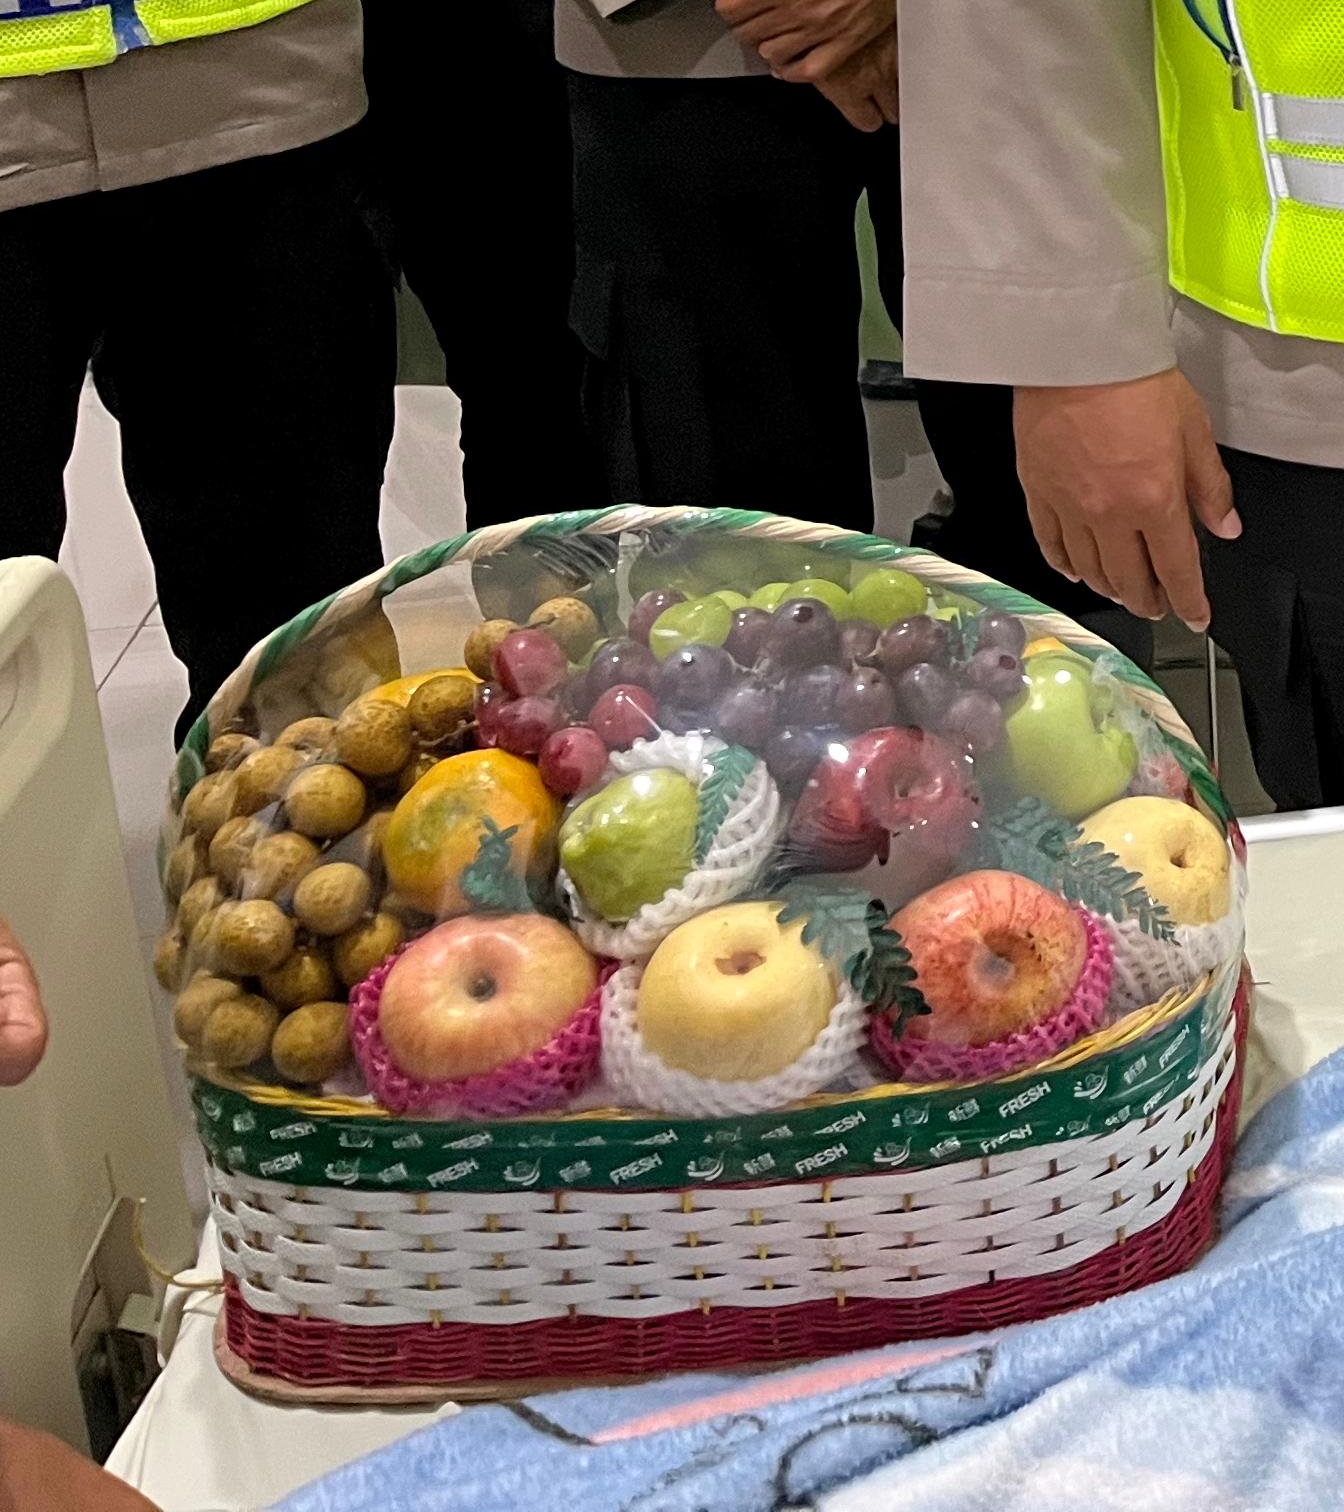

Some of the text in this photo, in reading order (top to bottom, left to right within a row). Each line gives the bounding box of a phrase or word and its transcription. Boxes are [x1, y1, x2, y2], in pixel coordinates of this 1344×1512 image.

[998, 1081, 1052, 1119] FRESH
[427, 1158, 479, 1187] FRESH
[609, 1152, 663, 1185] FRESH
[794, 1142, 849, 1175] FRESH
